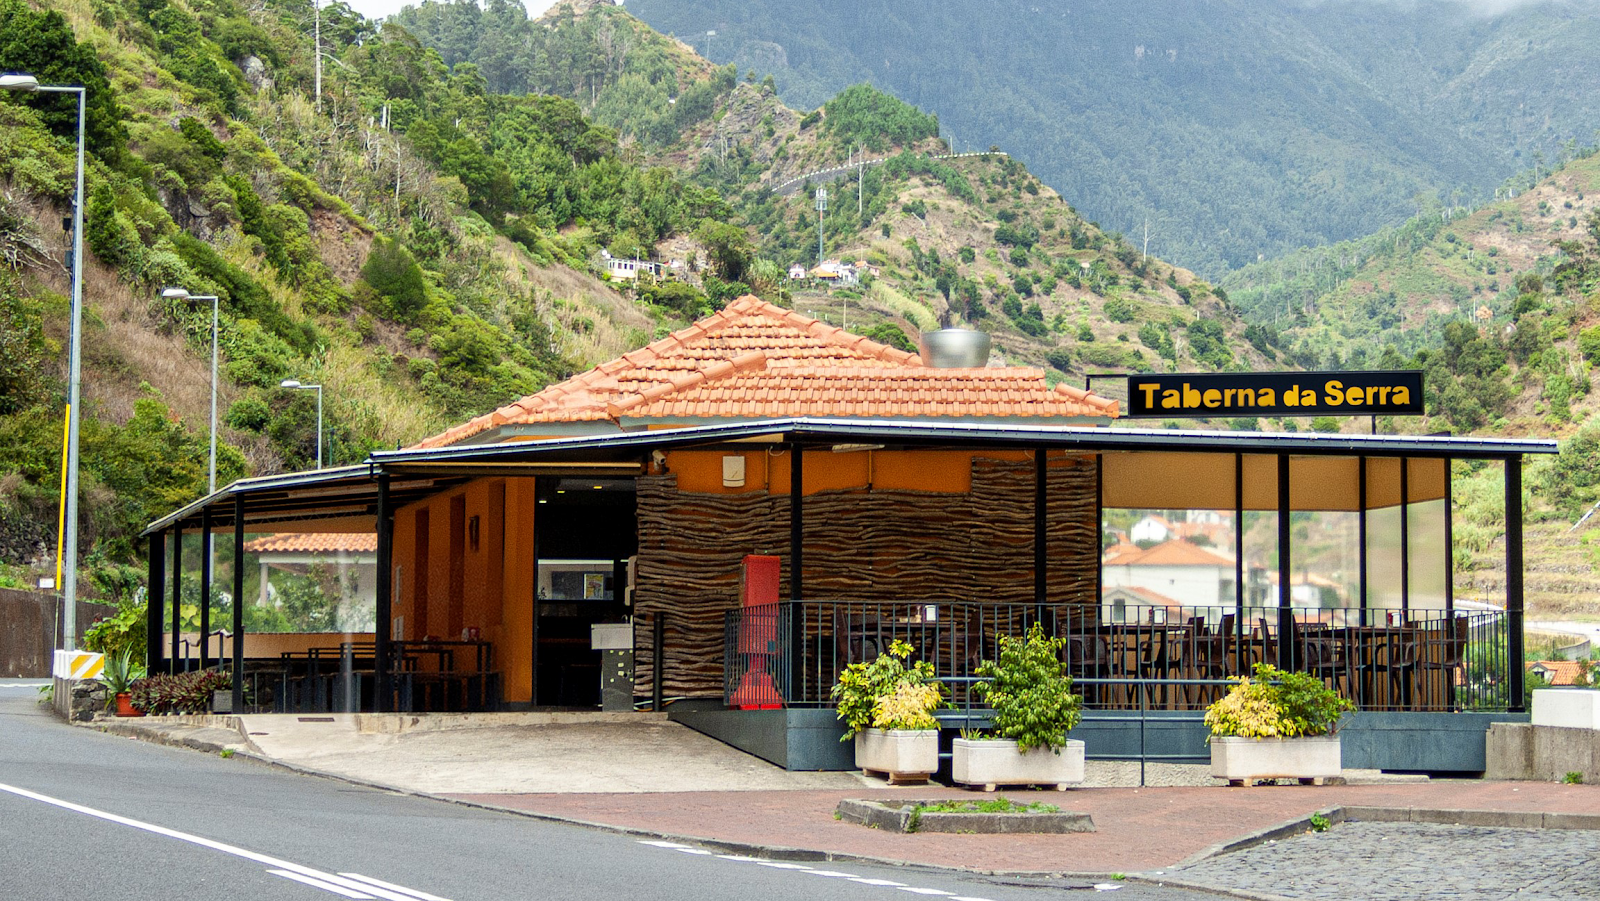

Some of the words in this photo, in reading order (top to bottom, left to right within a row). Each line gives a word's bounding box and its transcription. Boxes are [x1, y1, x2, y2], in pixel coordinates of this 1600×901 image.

[1139, 383, 1276, 409] Taberna
[1283, 385, 1318, 407] da
[1324, 380, 1411, 406] Serra
